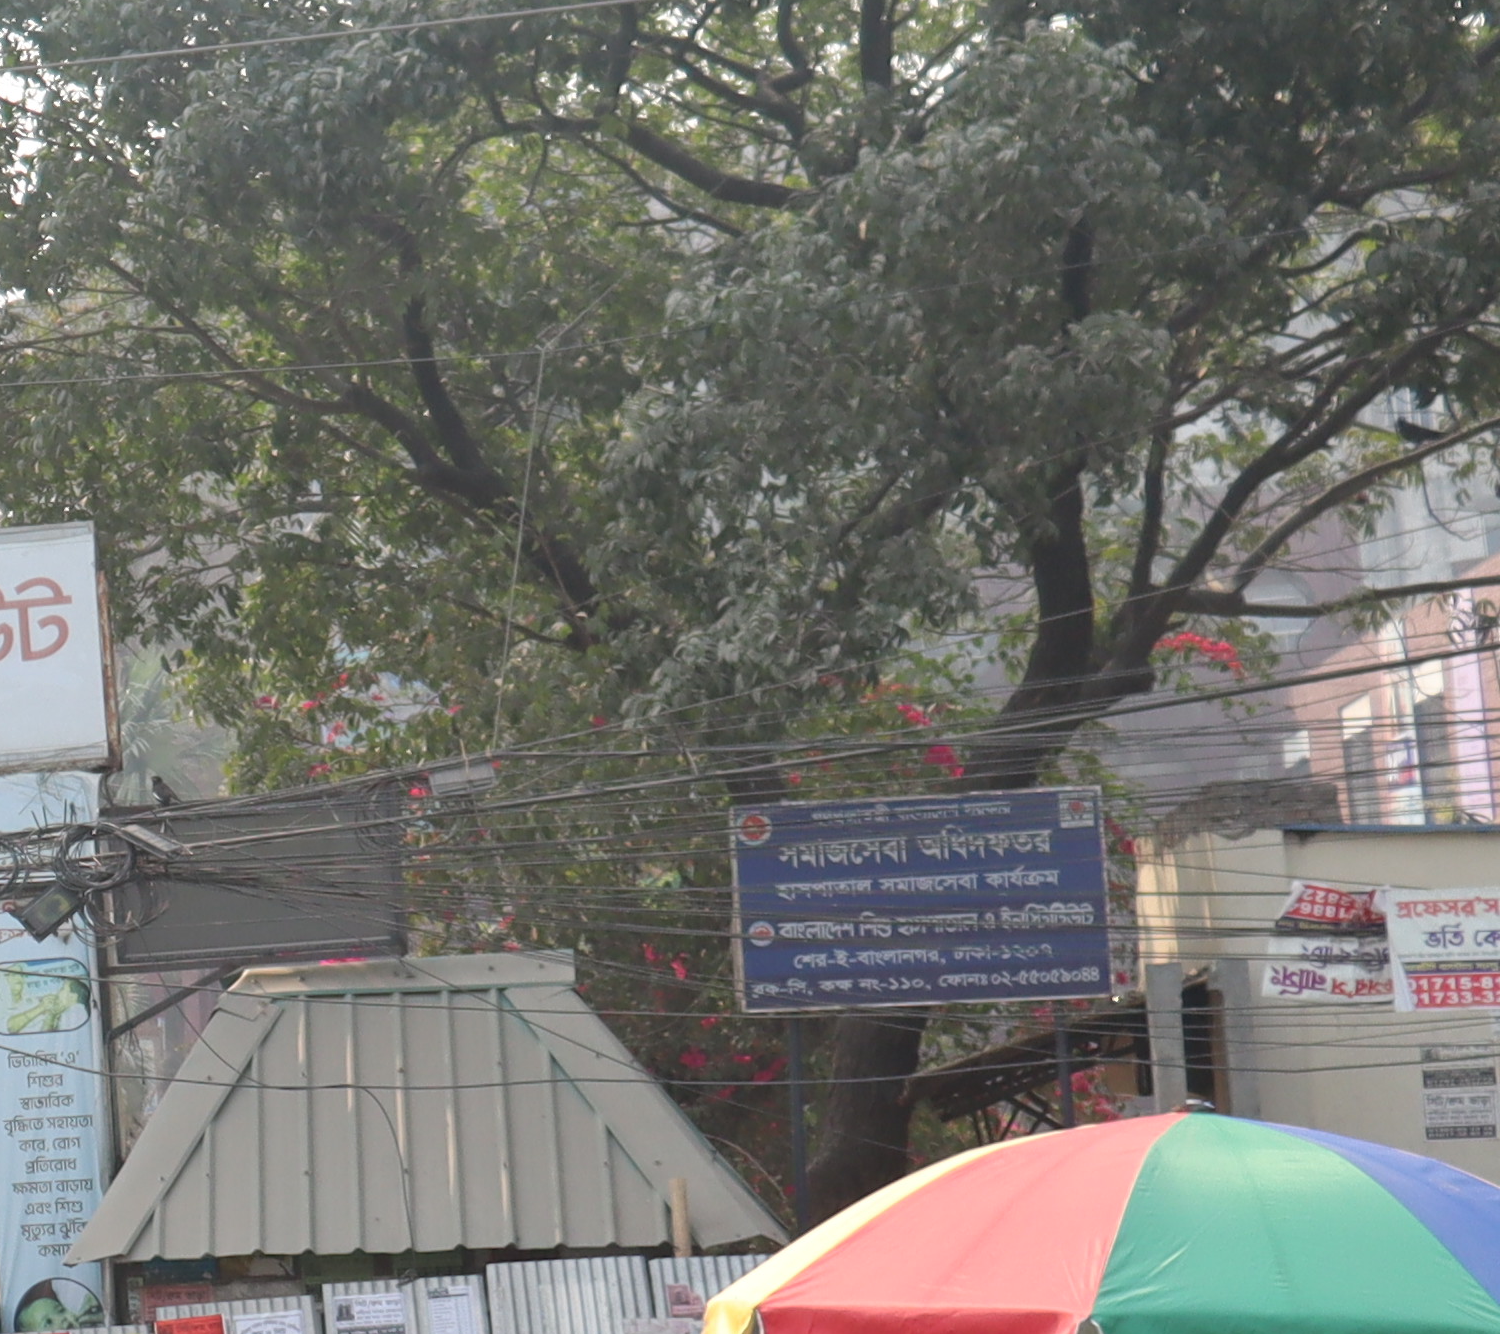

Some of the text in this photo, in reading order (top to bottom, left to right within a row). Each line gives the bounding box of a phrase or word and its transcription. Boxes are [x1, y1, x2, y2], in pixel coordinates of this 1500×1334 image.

[778, 836, 907, 868] সমাজসেবা
[879, 872, 978, 891] সমাজসেবা
[982, 866, 1060, 888] কার্যক্রম
[1424, 922, 1465, 950] ভর্তি
[27, 1071, 64, 1088] শিশুর
[19, 1091, 74, 1111] স্বাভাবিক
[47, 1114, 94, 1130] সহায়তা
[52, 1137, 81, 1151] রোগ
[25, 1155, 77, 1175] প্রতিরোধ
[11, 1178, 93, 1195] ক্ষমতা বাড়ায়
[24, 1197, 84, 1216] এবং শিশু
